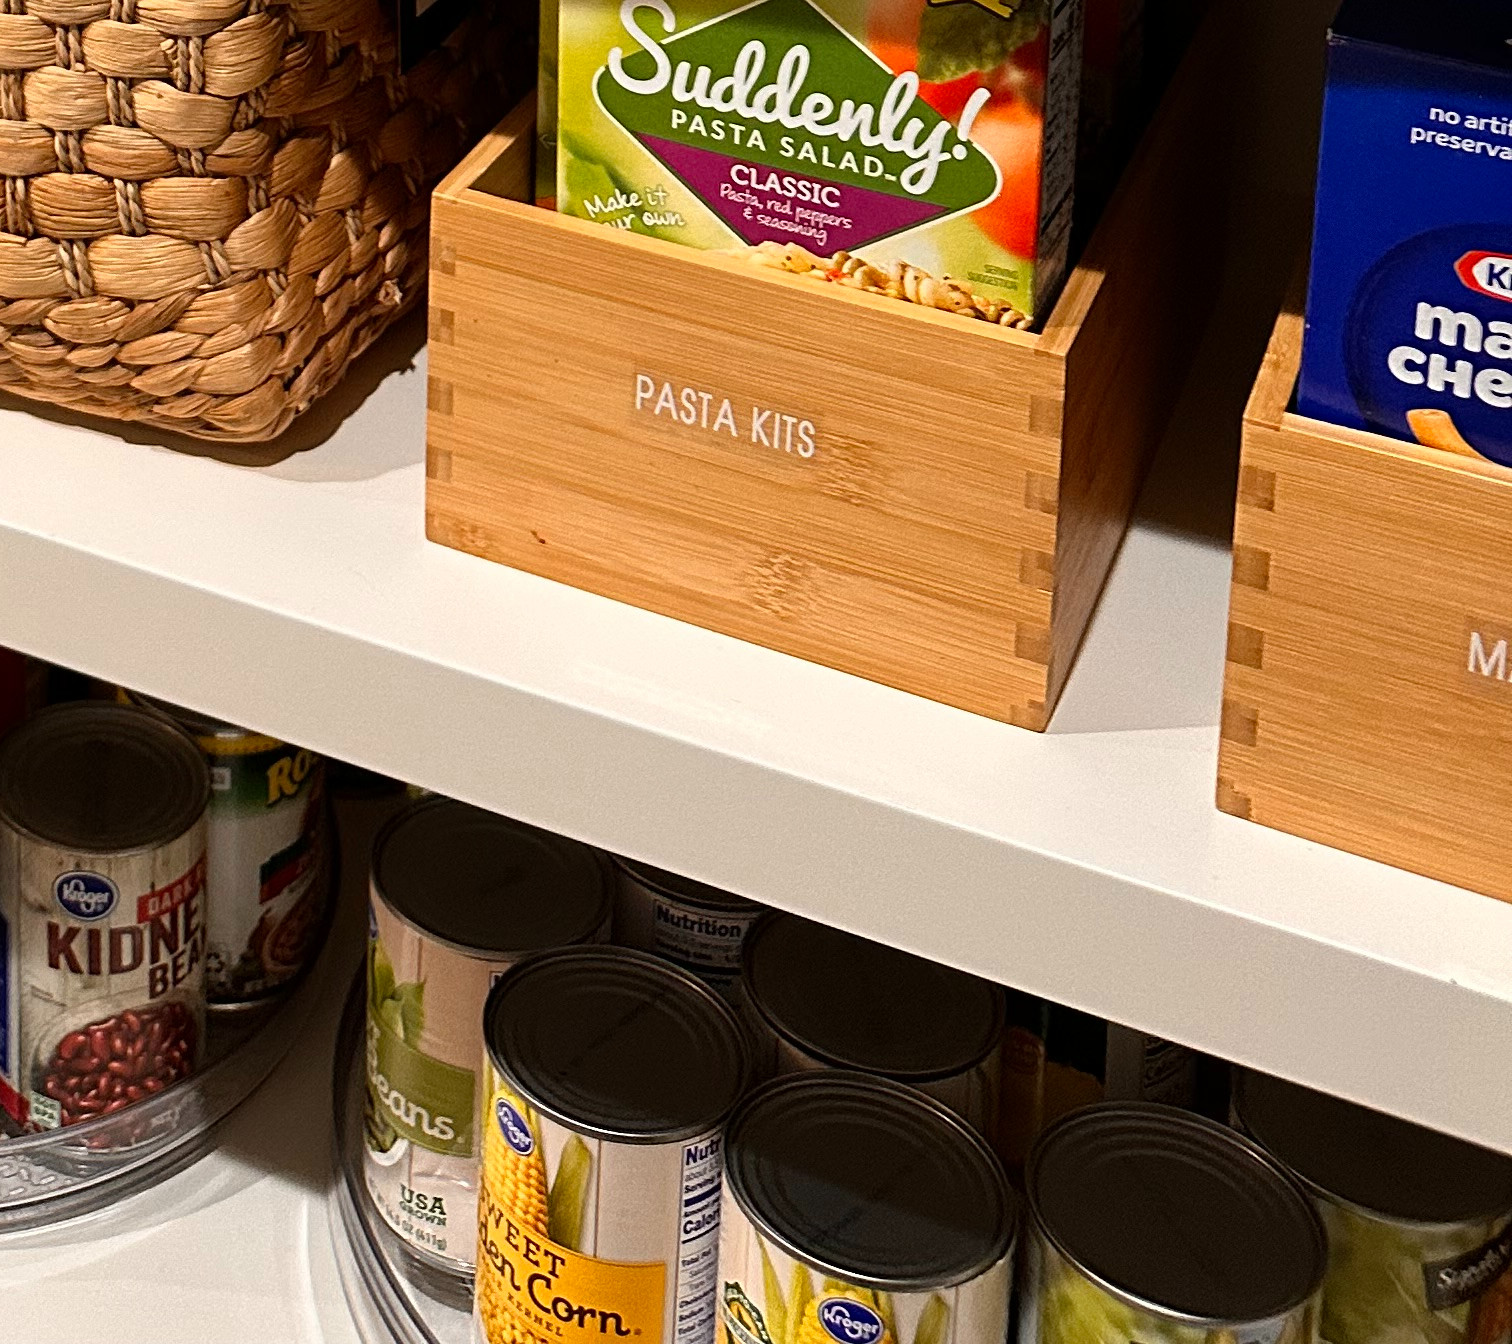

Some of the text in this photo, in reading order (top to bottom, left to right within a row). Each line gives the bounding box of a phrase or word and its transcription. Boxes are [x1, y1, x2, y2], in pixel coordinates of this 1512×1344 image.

[1429, 107, 1461, 125] no
[670, 108, 886, 179] PASTA SALAD
[583, 184, 668, 219] Make it
[729, 164, 842, 210] CLASSIC
[642, 210, 687, 228] own
[719, 182, 854, 231] Pasta, red peppers
[756, 213, 828, 247] seasoning
[635, 373, 816, 459] PASTA KITS
[61, 878, 110, 914] Kroger
[656, 904, 742, 938] Nutrition
[374, 1071, 456, 1141] eans
[399, 1200, 447, 1227] GROWN
[400, 1184, 447, 1216] USA
[527, 1272, 632, 1337] Corn
[823, 1304, 880, 1340] Kroger
